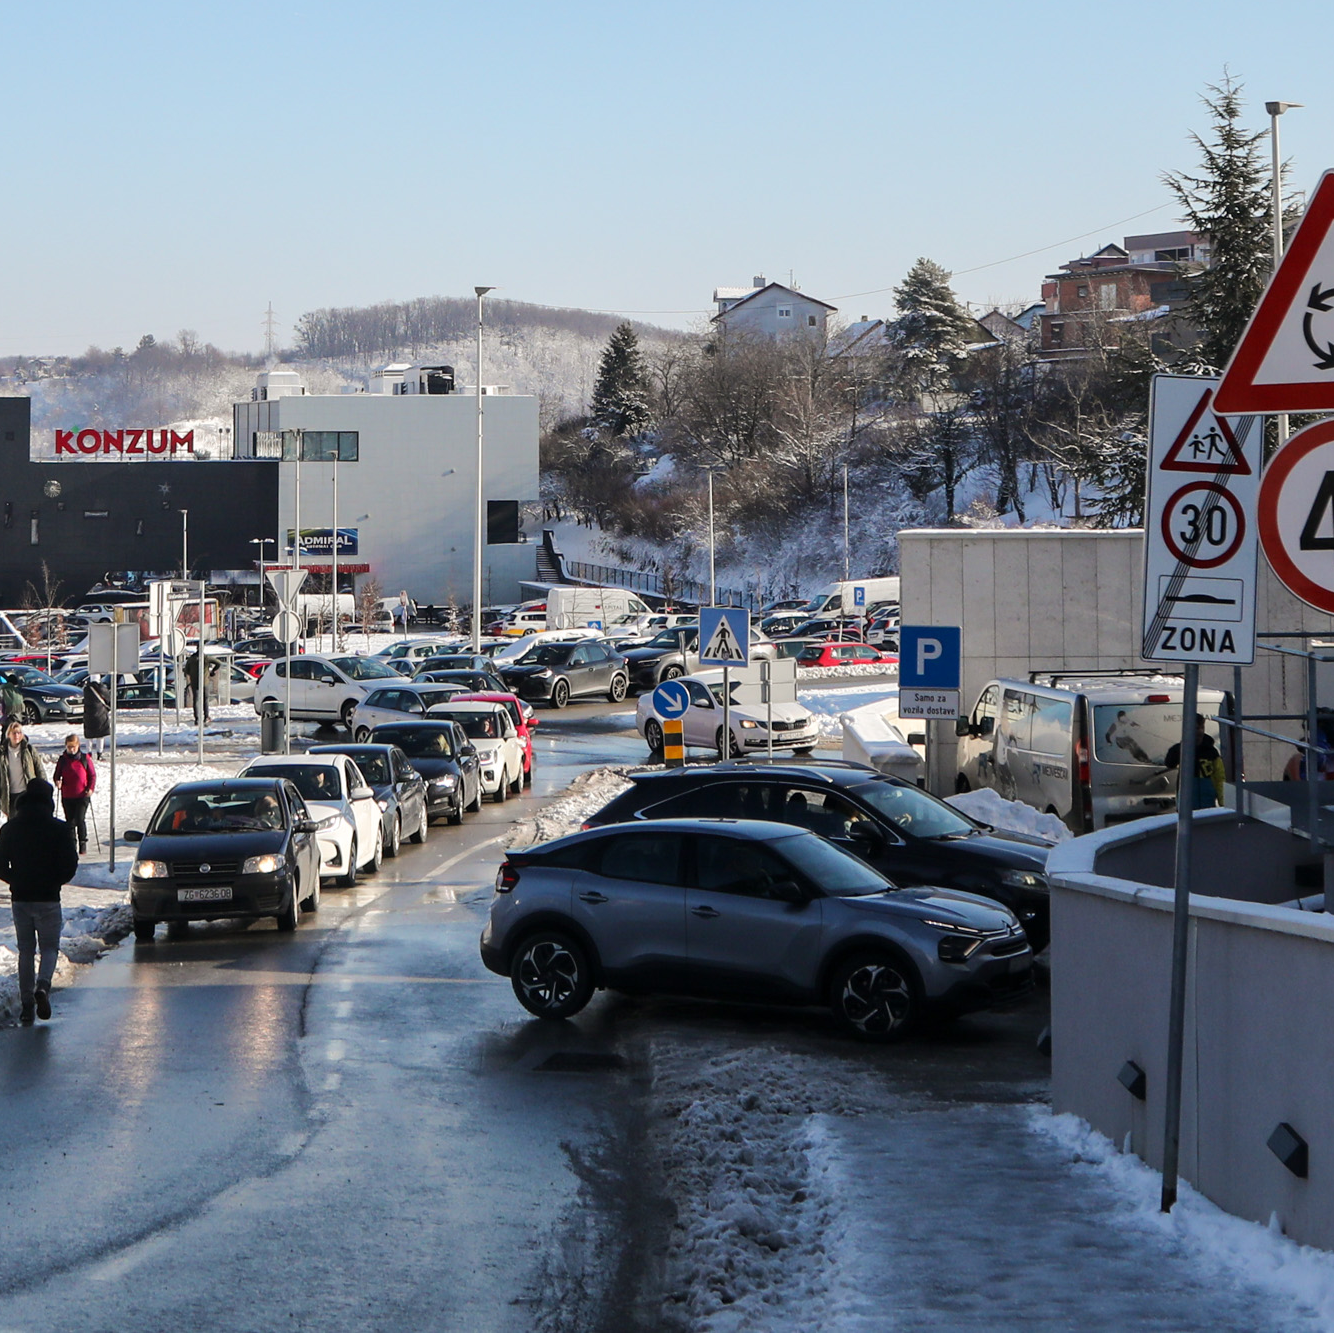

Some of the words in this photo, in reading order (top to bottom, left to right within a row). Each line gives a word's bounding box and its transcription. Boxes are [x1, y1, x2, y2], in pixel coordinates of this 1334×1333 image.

[55, 428, 194, 454] KONZUM
[1180, 504, 1227, 546] 30
[1161, 626, 1236, 654] ZONA
[916, 638, 943, 676] P
[903, 706, 924, 715] vozila
[926, 706, 956, 716] dostave
[914, 693, 935, 703] Samo
[937, 695, 947, 703] za
[184, 889, 195, 900] ZG
